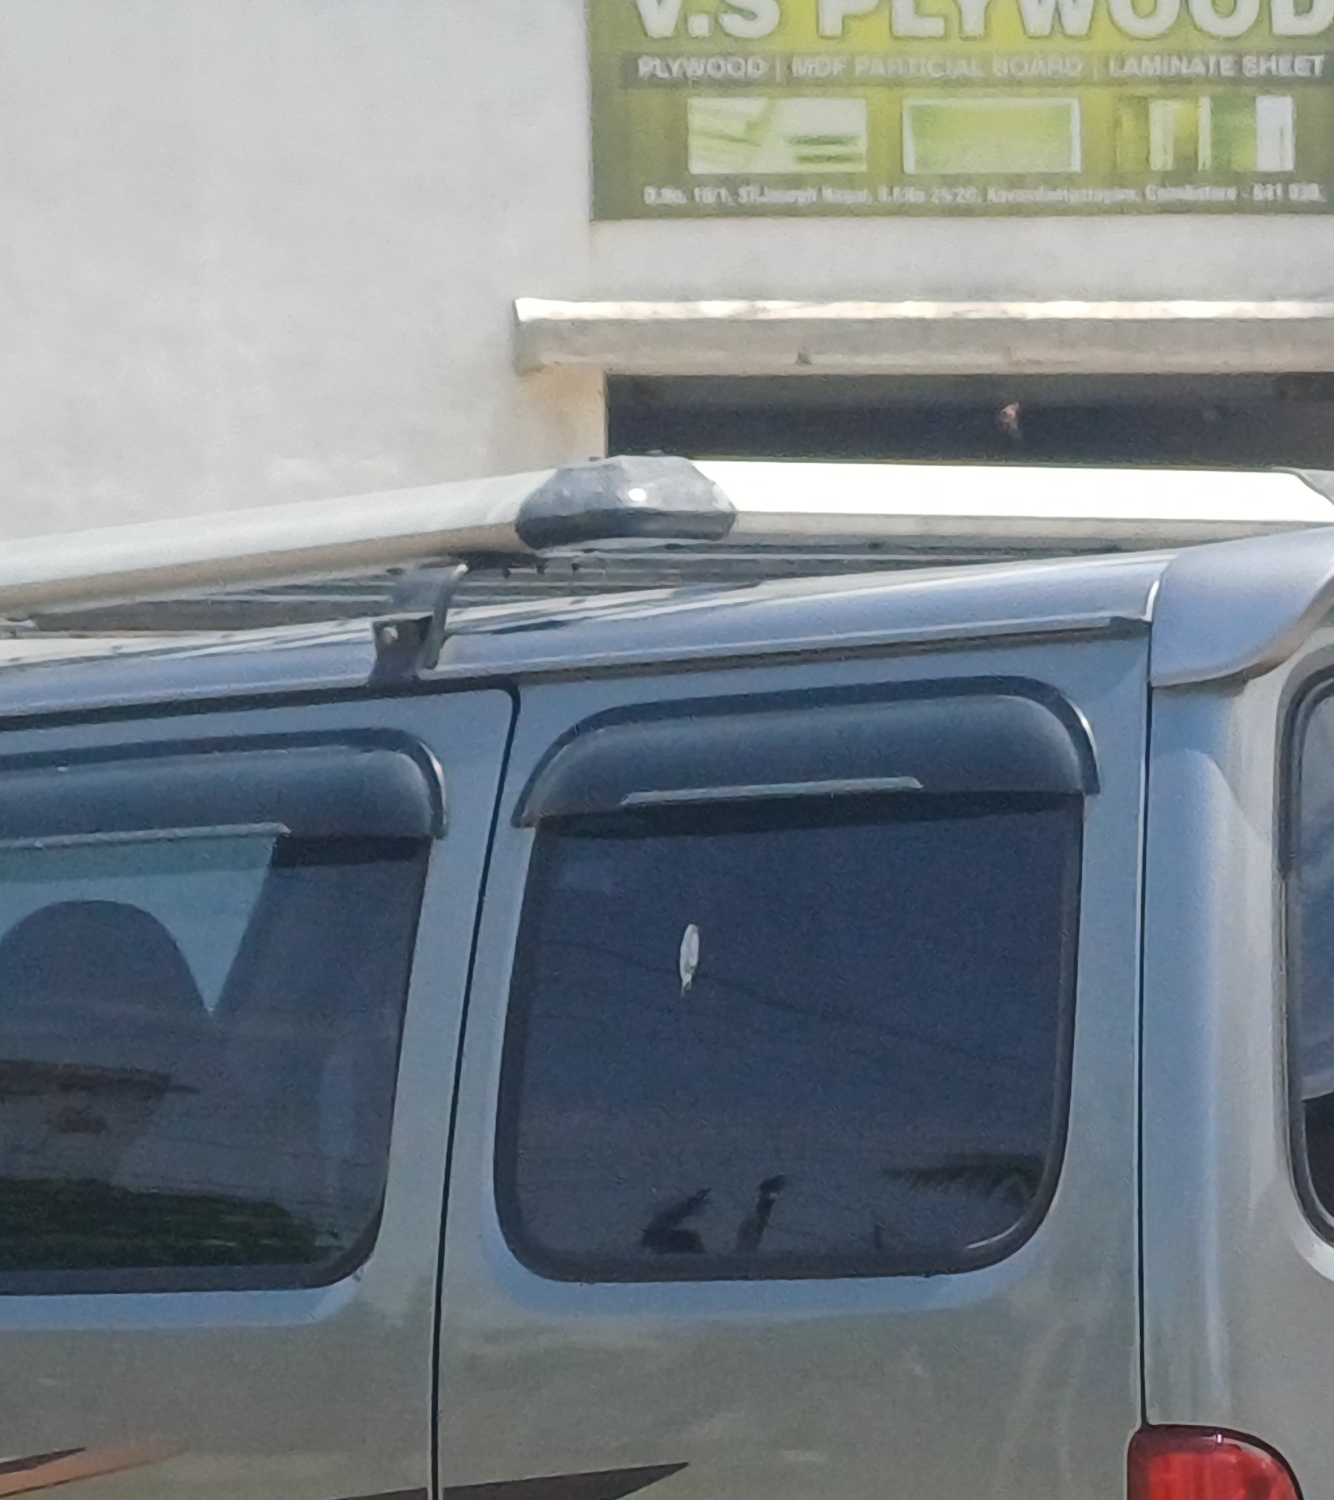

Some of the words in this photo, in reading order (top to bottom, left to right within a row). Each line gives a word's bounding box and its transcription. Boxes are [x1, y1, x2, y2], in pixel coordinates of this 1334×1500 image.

[638, 55, 767, 80] PLYWOOD
[791, 55, 846, 78] MDF
[1108, 54, 1236, 78] LAMINATE
[1242, 54, 1325, 78] SHEET
